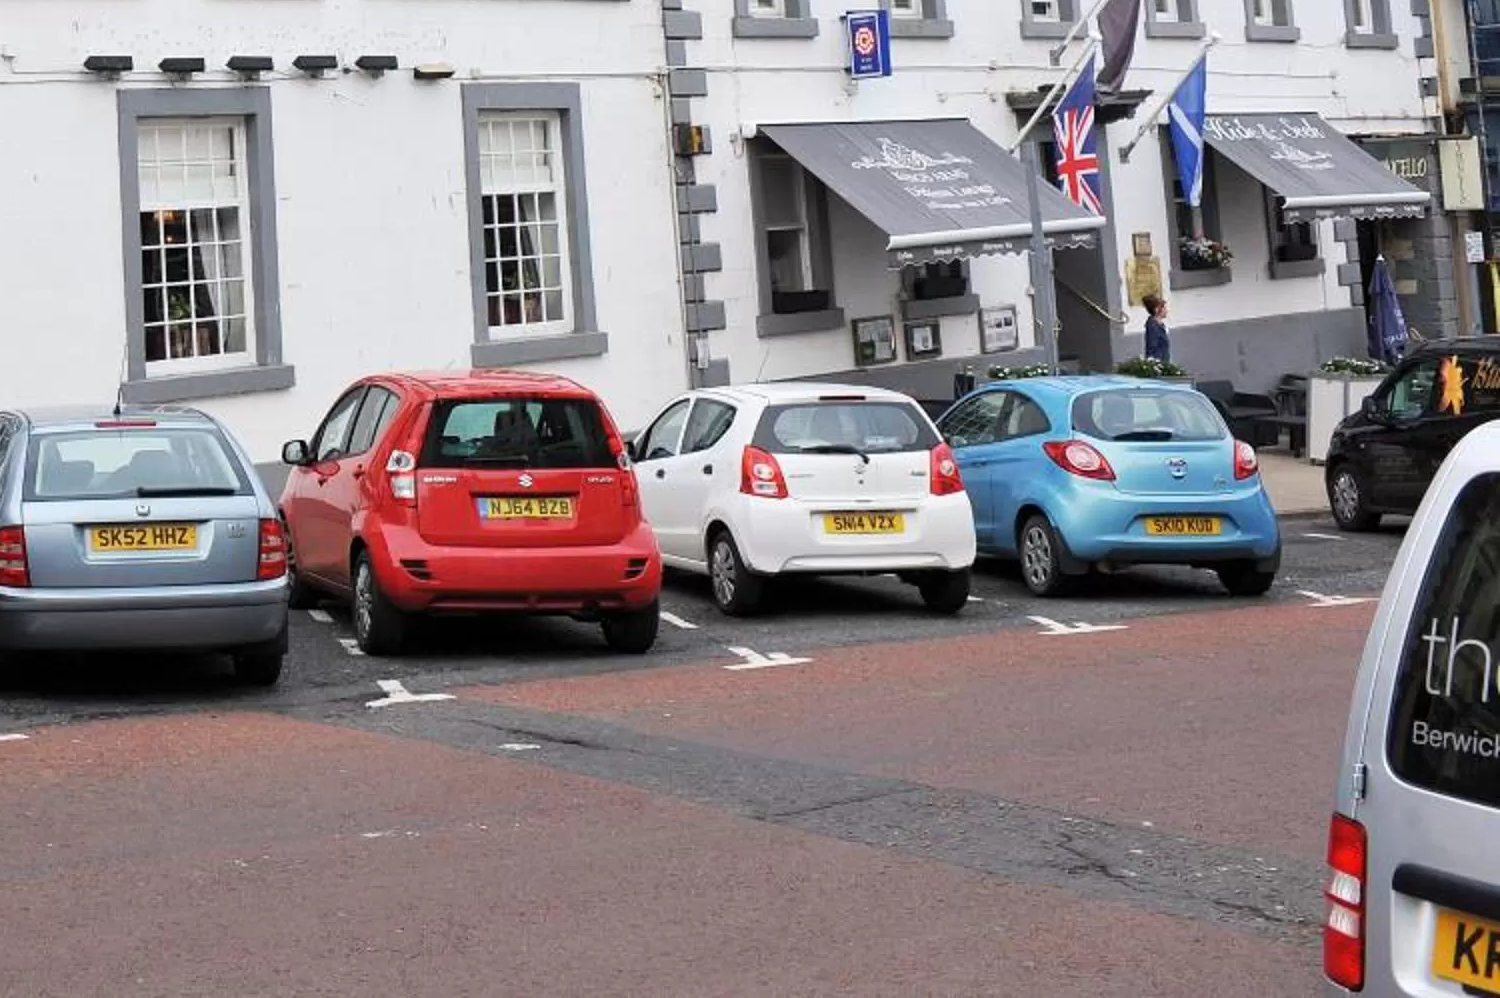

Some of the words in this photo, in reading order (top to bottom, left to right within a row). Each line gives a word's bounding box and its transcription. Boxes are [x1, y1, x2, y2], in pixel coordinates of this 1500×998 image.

[833, 516, 865, 531] SN14
[867, 515, 896, 530] VZX
[97, 528, 147, 547] SK52
[152, 527, 189, 546] HHZ
[1422, 616, 1500, 703] th
